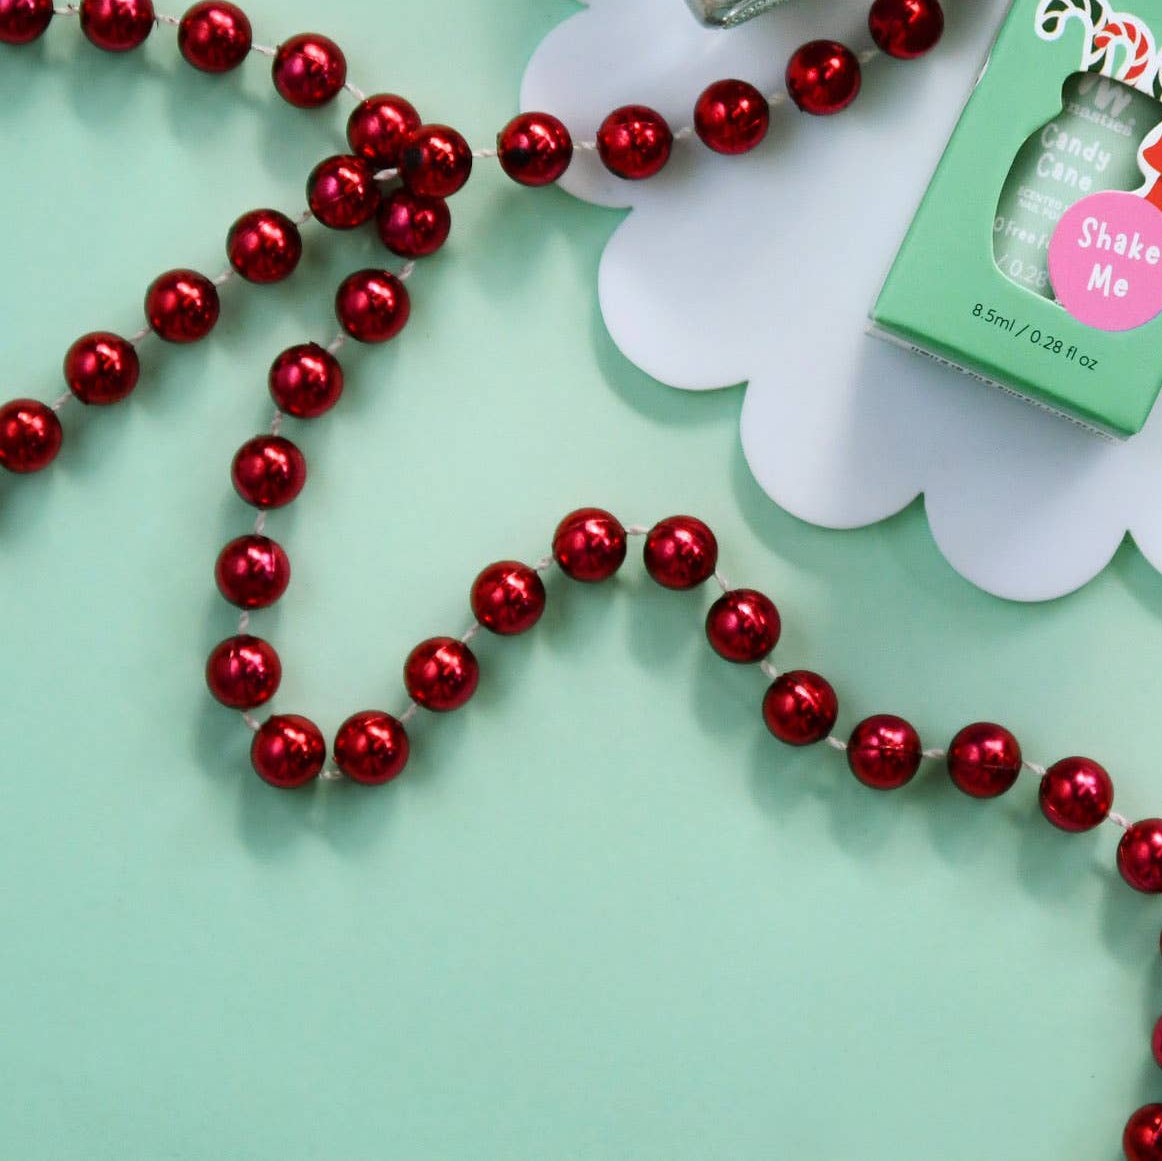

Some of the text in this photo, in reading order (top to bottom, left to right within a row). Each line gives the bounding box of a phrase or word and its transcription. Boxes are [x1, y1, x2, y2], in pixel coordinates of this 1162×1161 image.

[1036, 152, 1092, 191] Cane
[1041, 123, 1111, 172] Candy
[1077, 217, 1161, 265] Shake
[1087, 263, 1129, 297] Me
[972, 303, 1099, 372] 8.5ml / 0.28 fl oz
